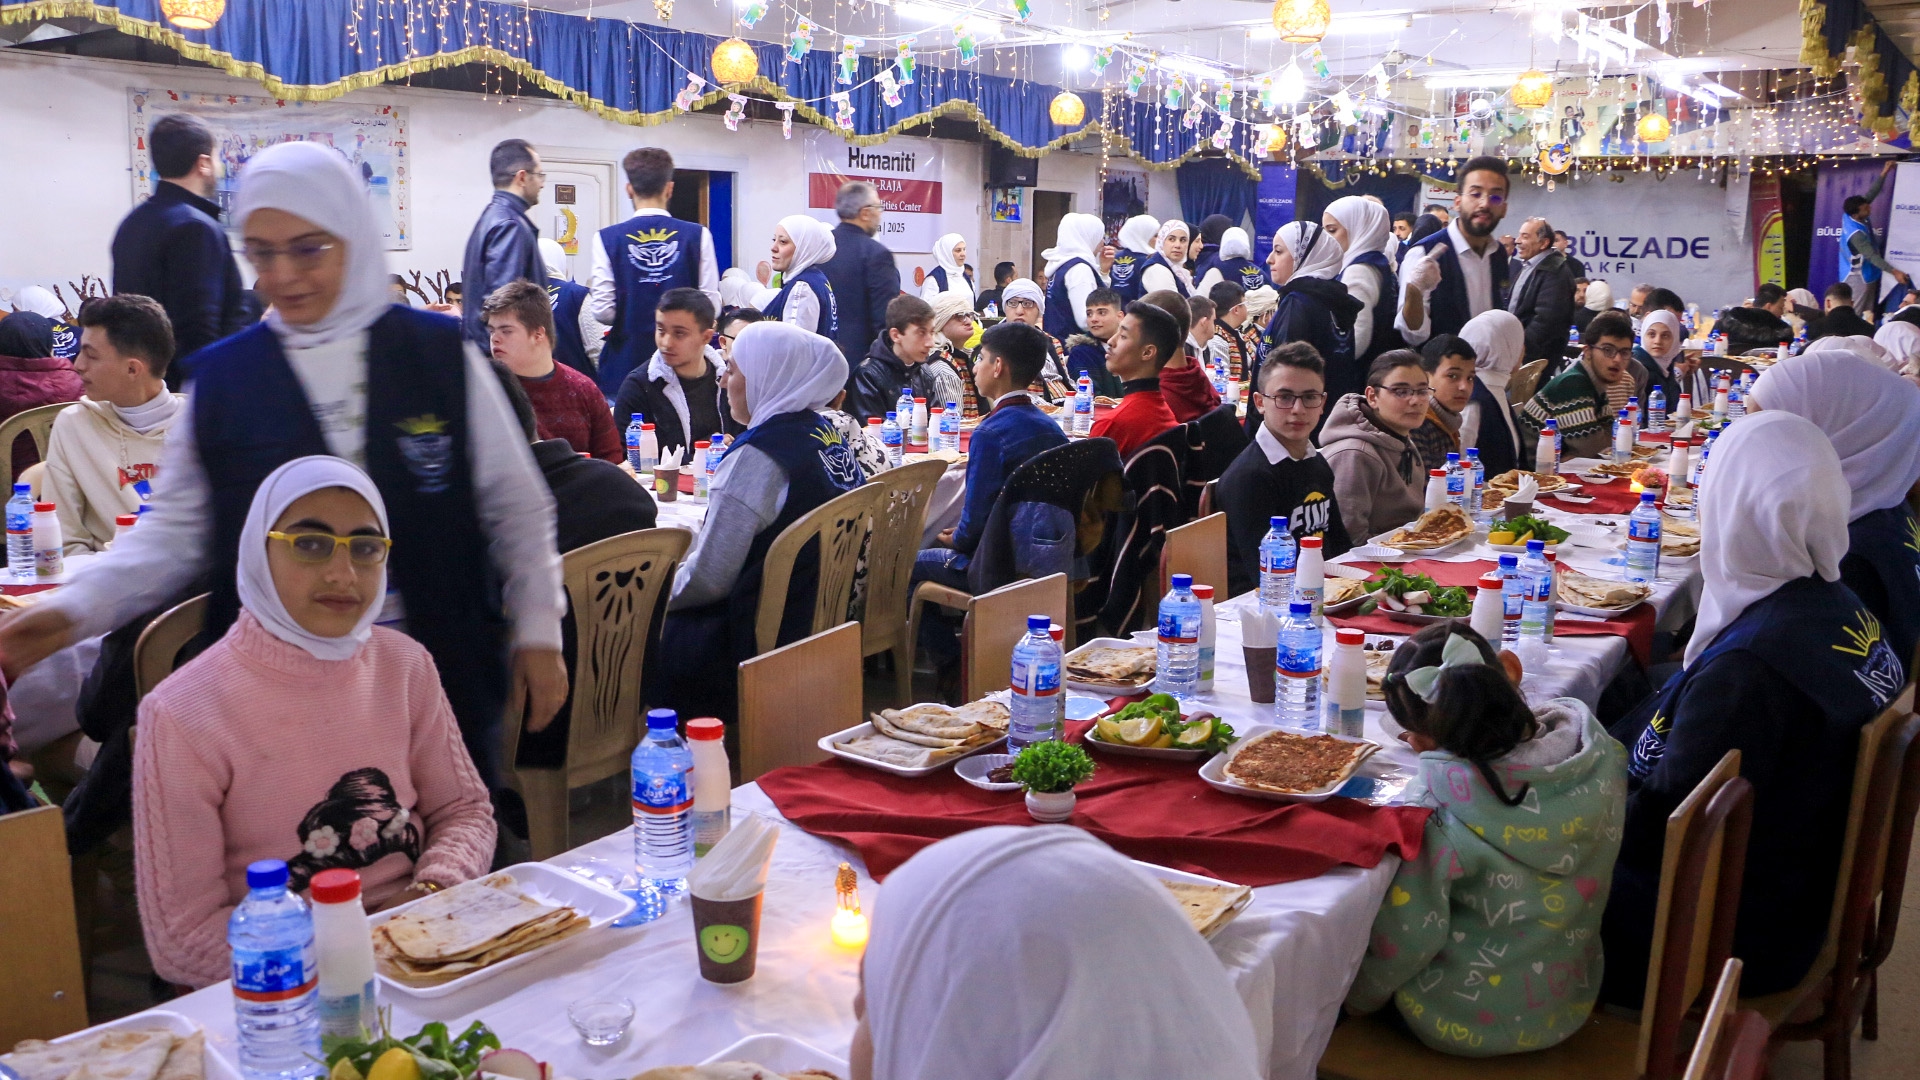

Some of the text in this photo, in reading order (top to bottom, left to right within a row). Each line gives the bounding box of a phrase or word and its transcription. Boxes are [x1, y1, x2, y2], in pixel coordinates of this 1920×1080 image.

[848, 146, 915, 172] Humaniti
[899, 201, 922, 212] Center
[1895, 203, 1920, 211] BÜLBÜ
[887, 222, 905, 233] 2025
[1566, 230, 1710, 259] BÜLZADE
[1584, 261, 1635, 274] AKFI
